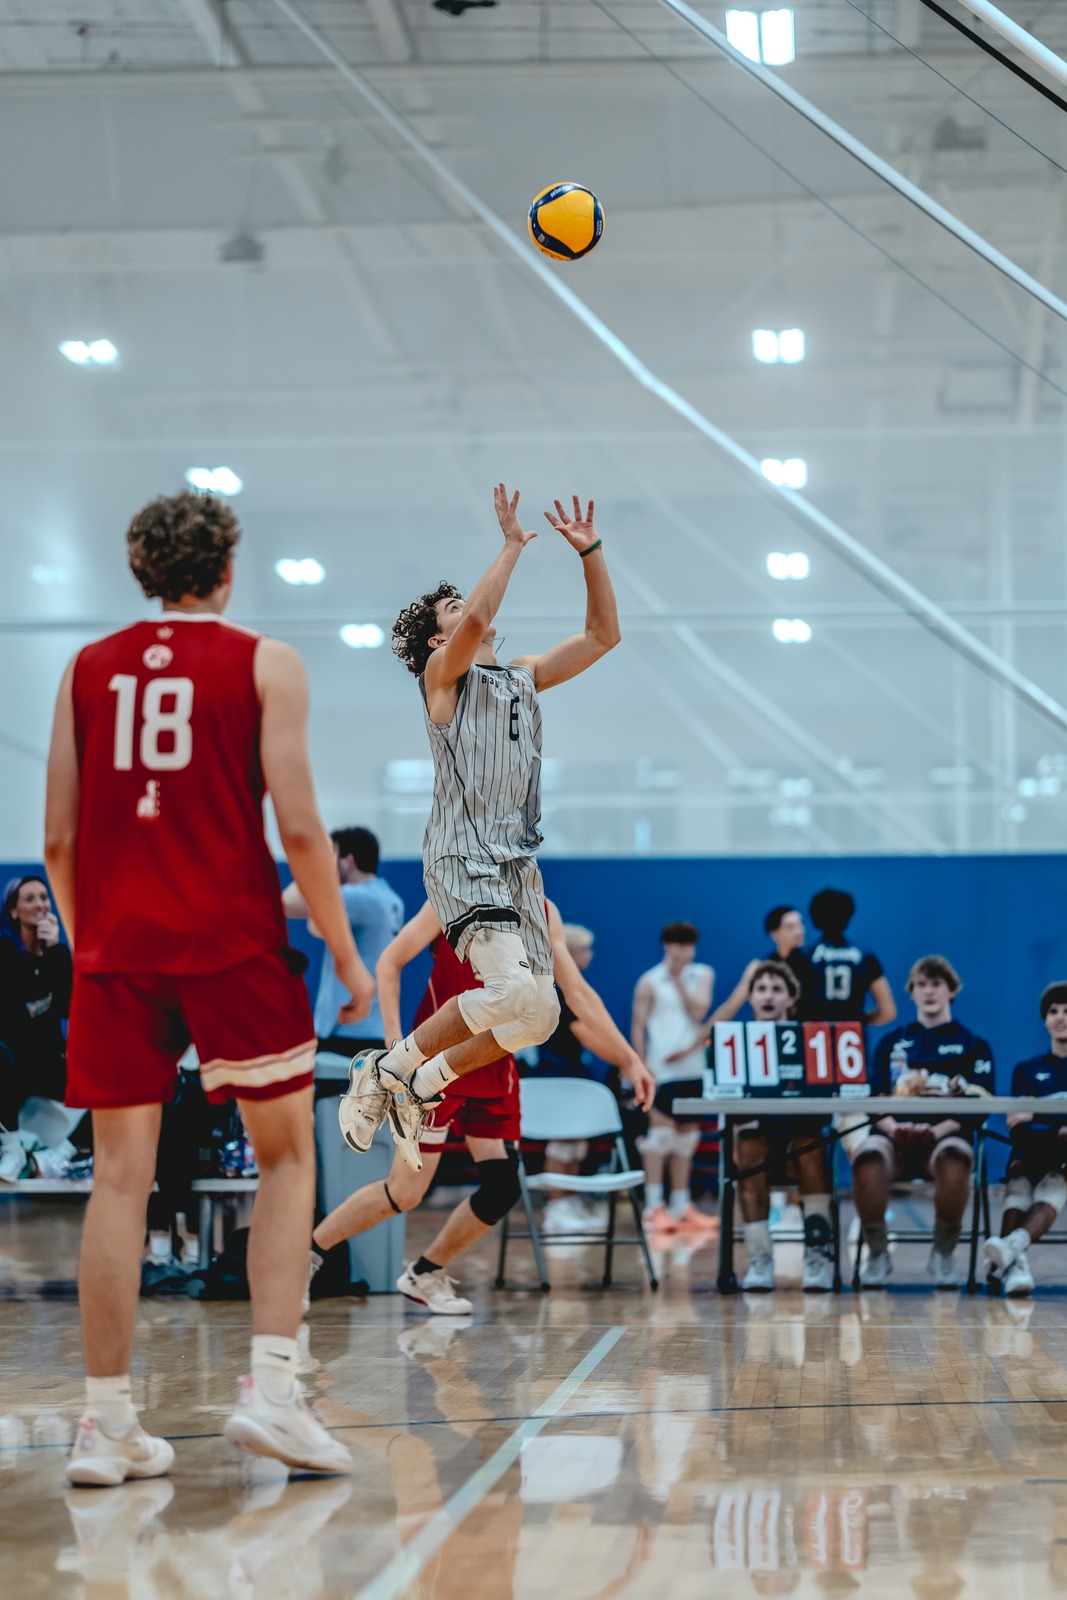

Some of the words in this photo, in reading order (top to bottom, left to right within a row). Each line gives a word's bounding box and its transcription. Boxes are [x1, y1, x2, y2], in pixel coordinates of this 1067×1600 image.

[108, 673, 194, 771] 18
[781, 1029, 797, 1055] 2
[809, 1030, 864, 1079] 16
